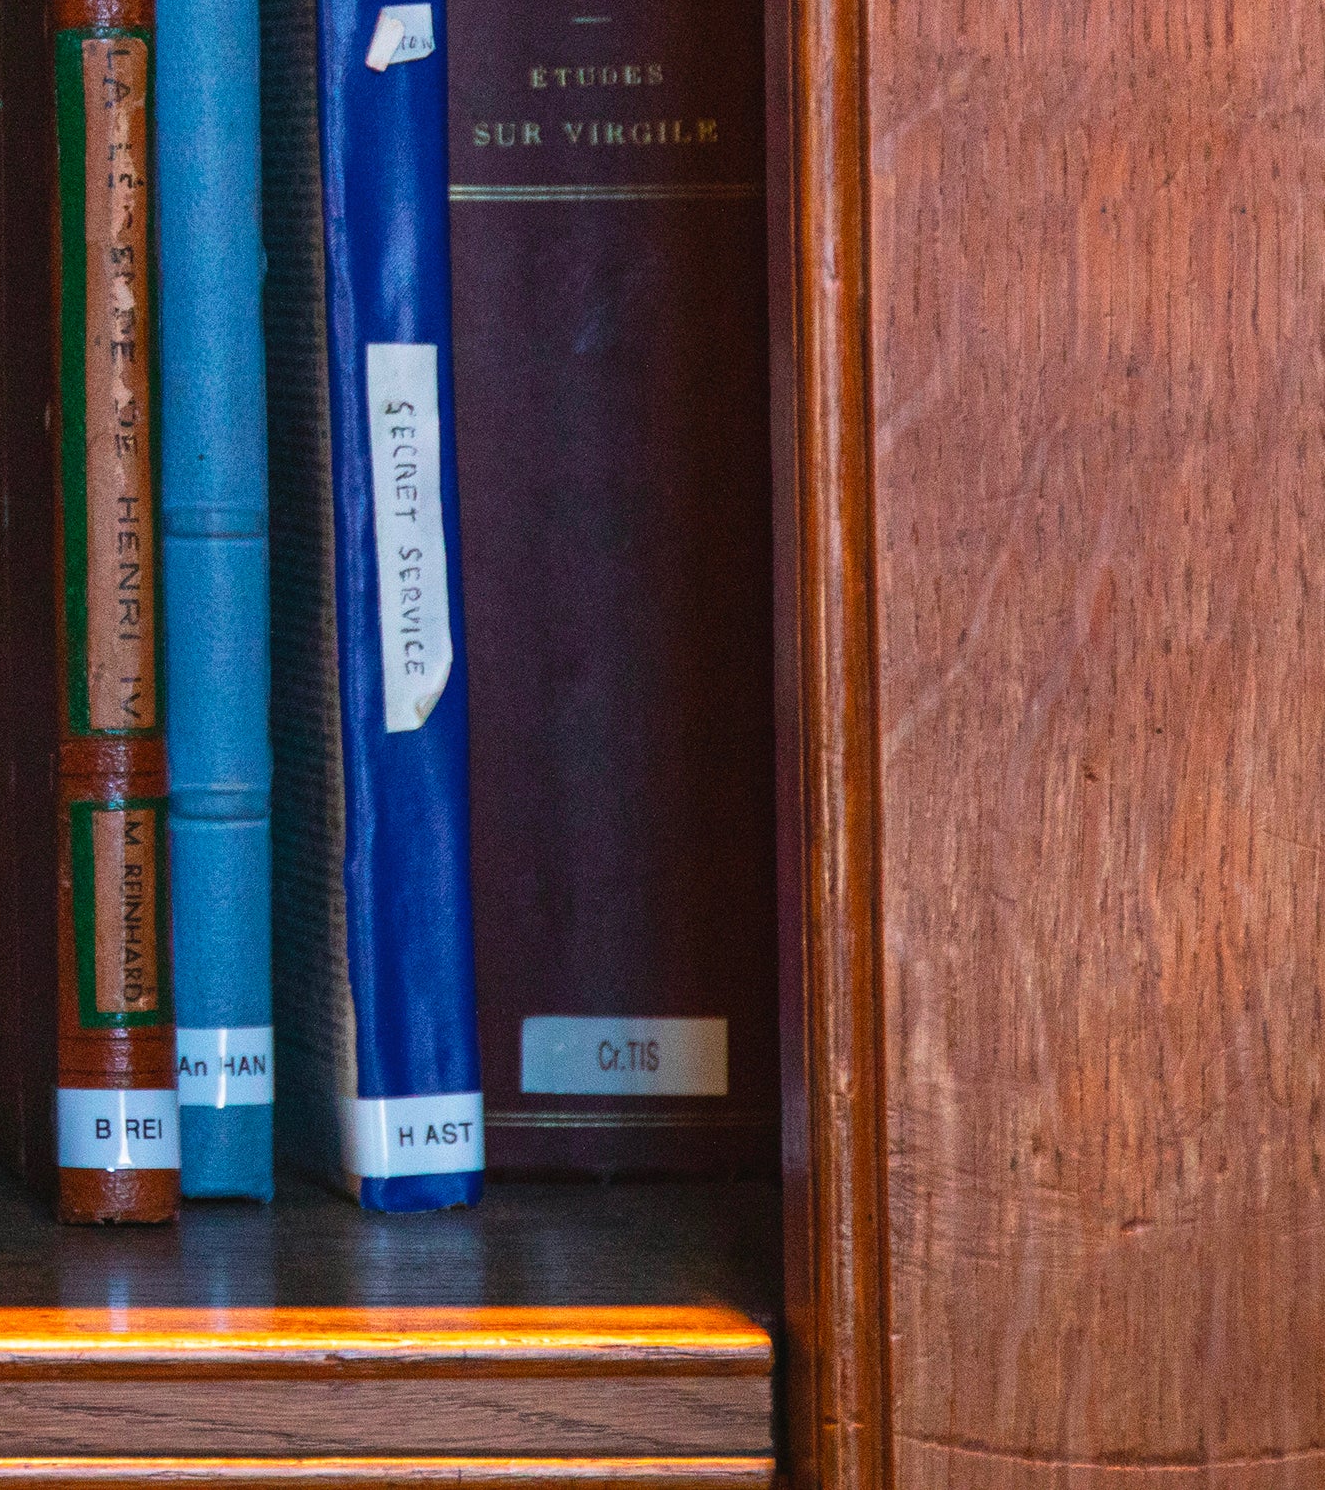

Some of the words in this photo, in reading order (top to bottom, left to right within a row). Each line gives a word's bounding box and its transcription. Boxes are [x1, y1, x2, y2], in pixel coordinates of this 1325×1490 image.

[472, 120, 543, 148] SUR
[564, 116, 721, 147] VIRGILE
[385, 399, 419, 523] SECRET
[116, 494, 141, 642] HENRI
[397, 545, 426, 678] SERVICE
[119, 676, 144, 721] IV
[122, 861, 147, 1004] REINHARD
[178, 1057, 208, 1077] An
[220, 1054, 267, 1076] HAN
[597, 1039, 661, 1074] Cr.TIS
[95, 1118, 112, 1140] B
[125, 1118, 163, 1140] REI
[398, 1126, 415, 1148] H
[424, 1121, 474, 1147] AST
